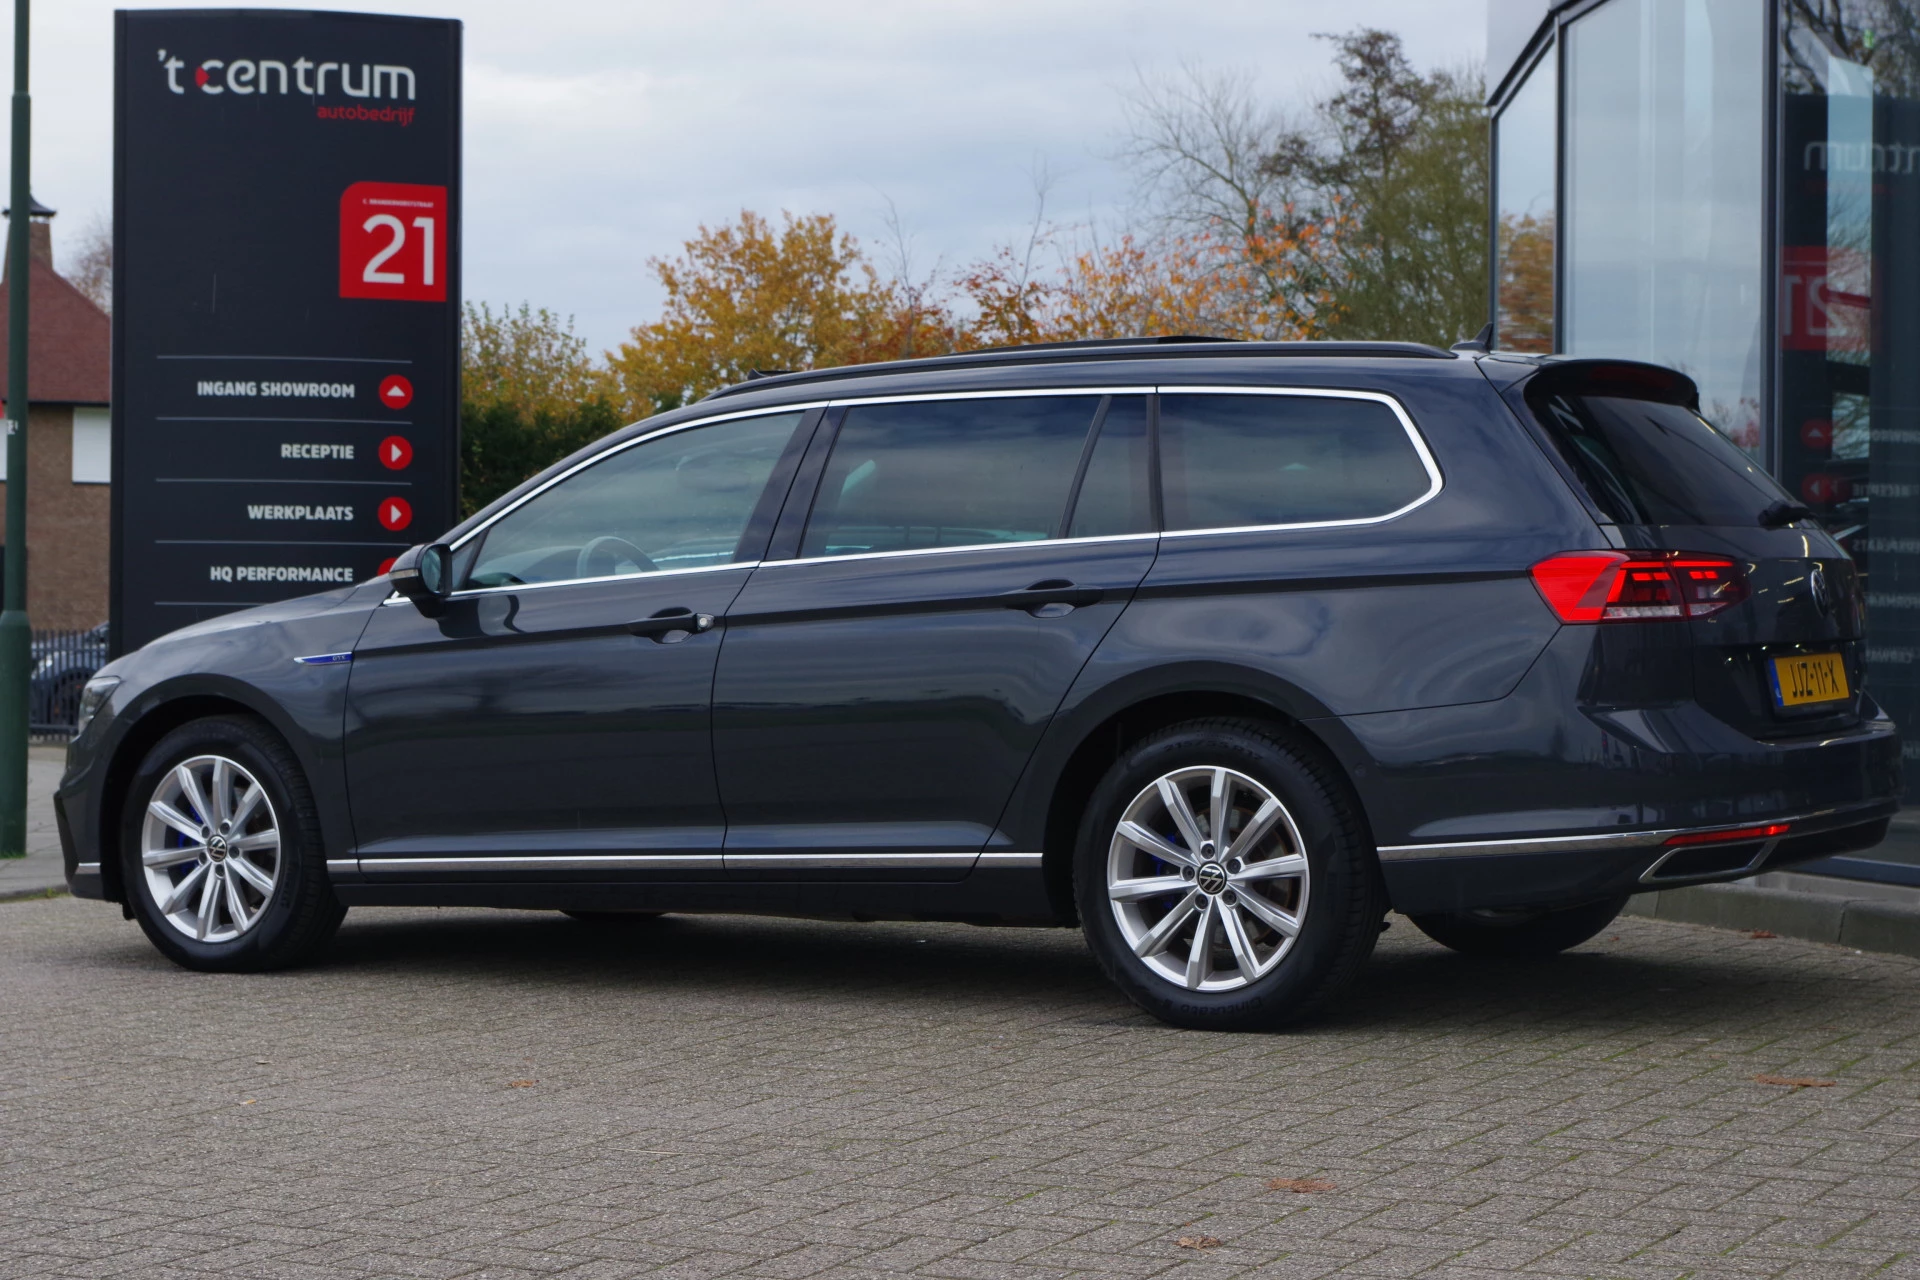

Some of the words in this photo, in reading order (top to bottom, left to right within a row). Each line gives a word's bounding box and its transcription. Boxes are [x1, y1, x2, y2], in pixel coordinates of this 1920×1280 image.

[195, 57, 416, 100] centrum
[317, 105, 415, 126] autobedrijf
[362, 214, 435, 286] 21
[197, 381, 257, 397] INGANG
[260, 381, 355, 398] SHOWROOM
[281, 443, 355, 460] RECEPTIE
[247, 505, 354, 521] WERKPLAATS
[210, 566, 232, 582] HQ
[236, 566, 354, 582] PERFORMANCE
